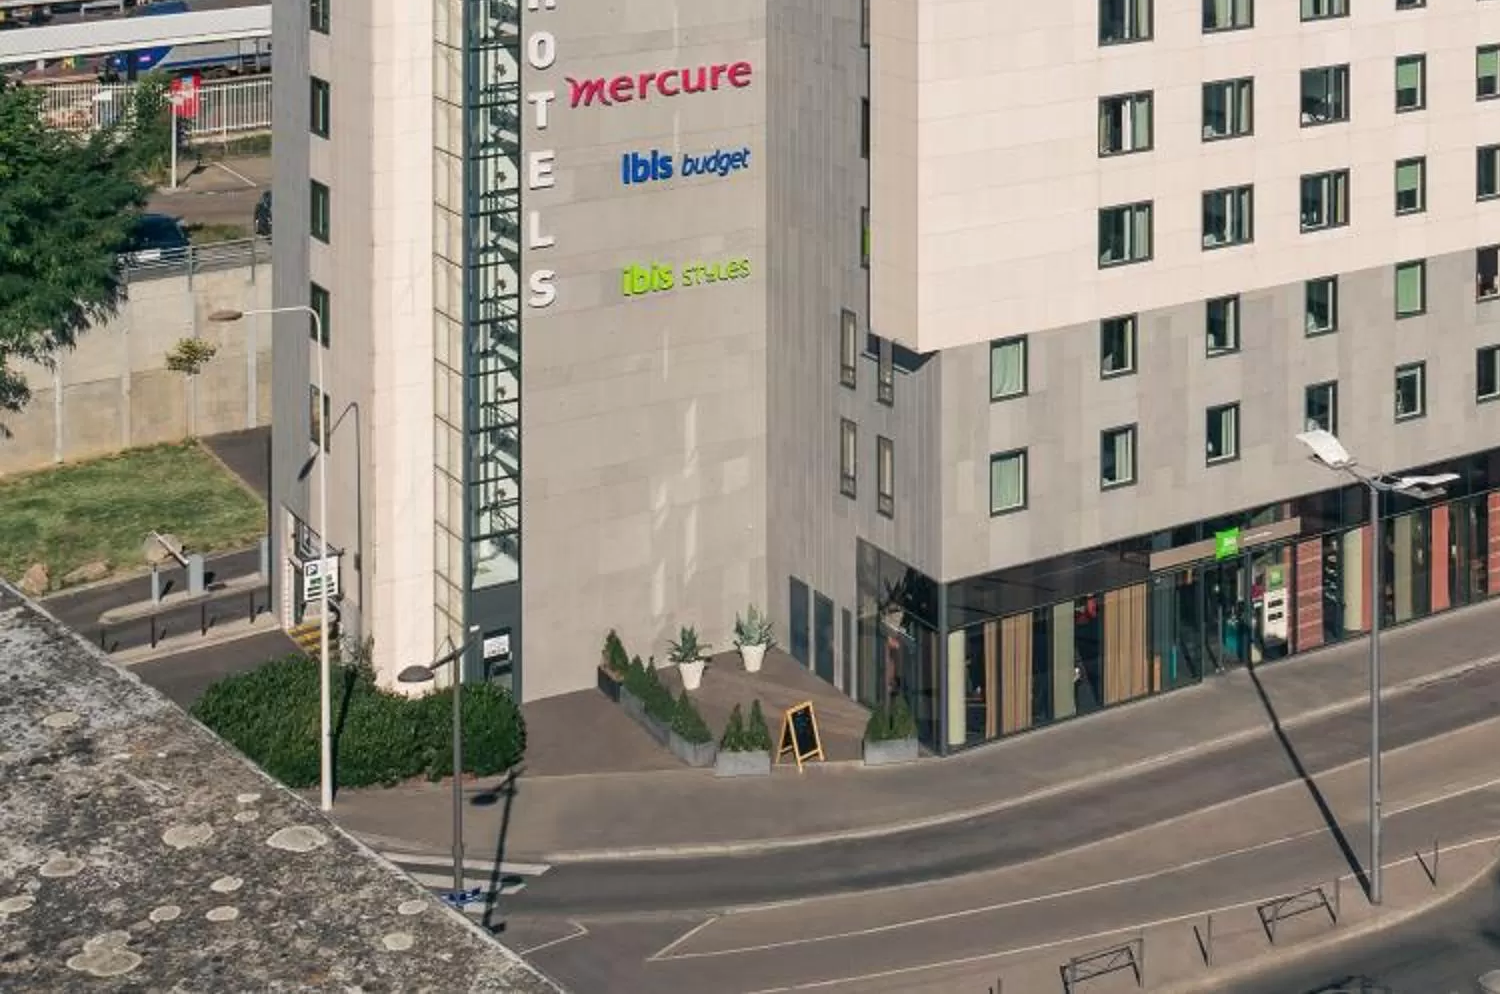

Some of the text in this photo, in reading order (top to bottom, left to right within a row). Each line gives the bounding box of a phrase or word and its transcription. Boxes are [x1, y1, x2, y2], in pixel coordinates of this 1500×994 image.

[564, 61, 752, 109] mercure
[623, 147, 751, 184] ibis budget
[623, 261, 673, 296] ibis
